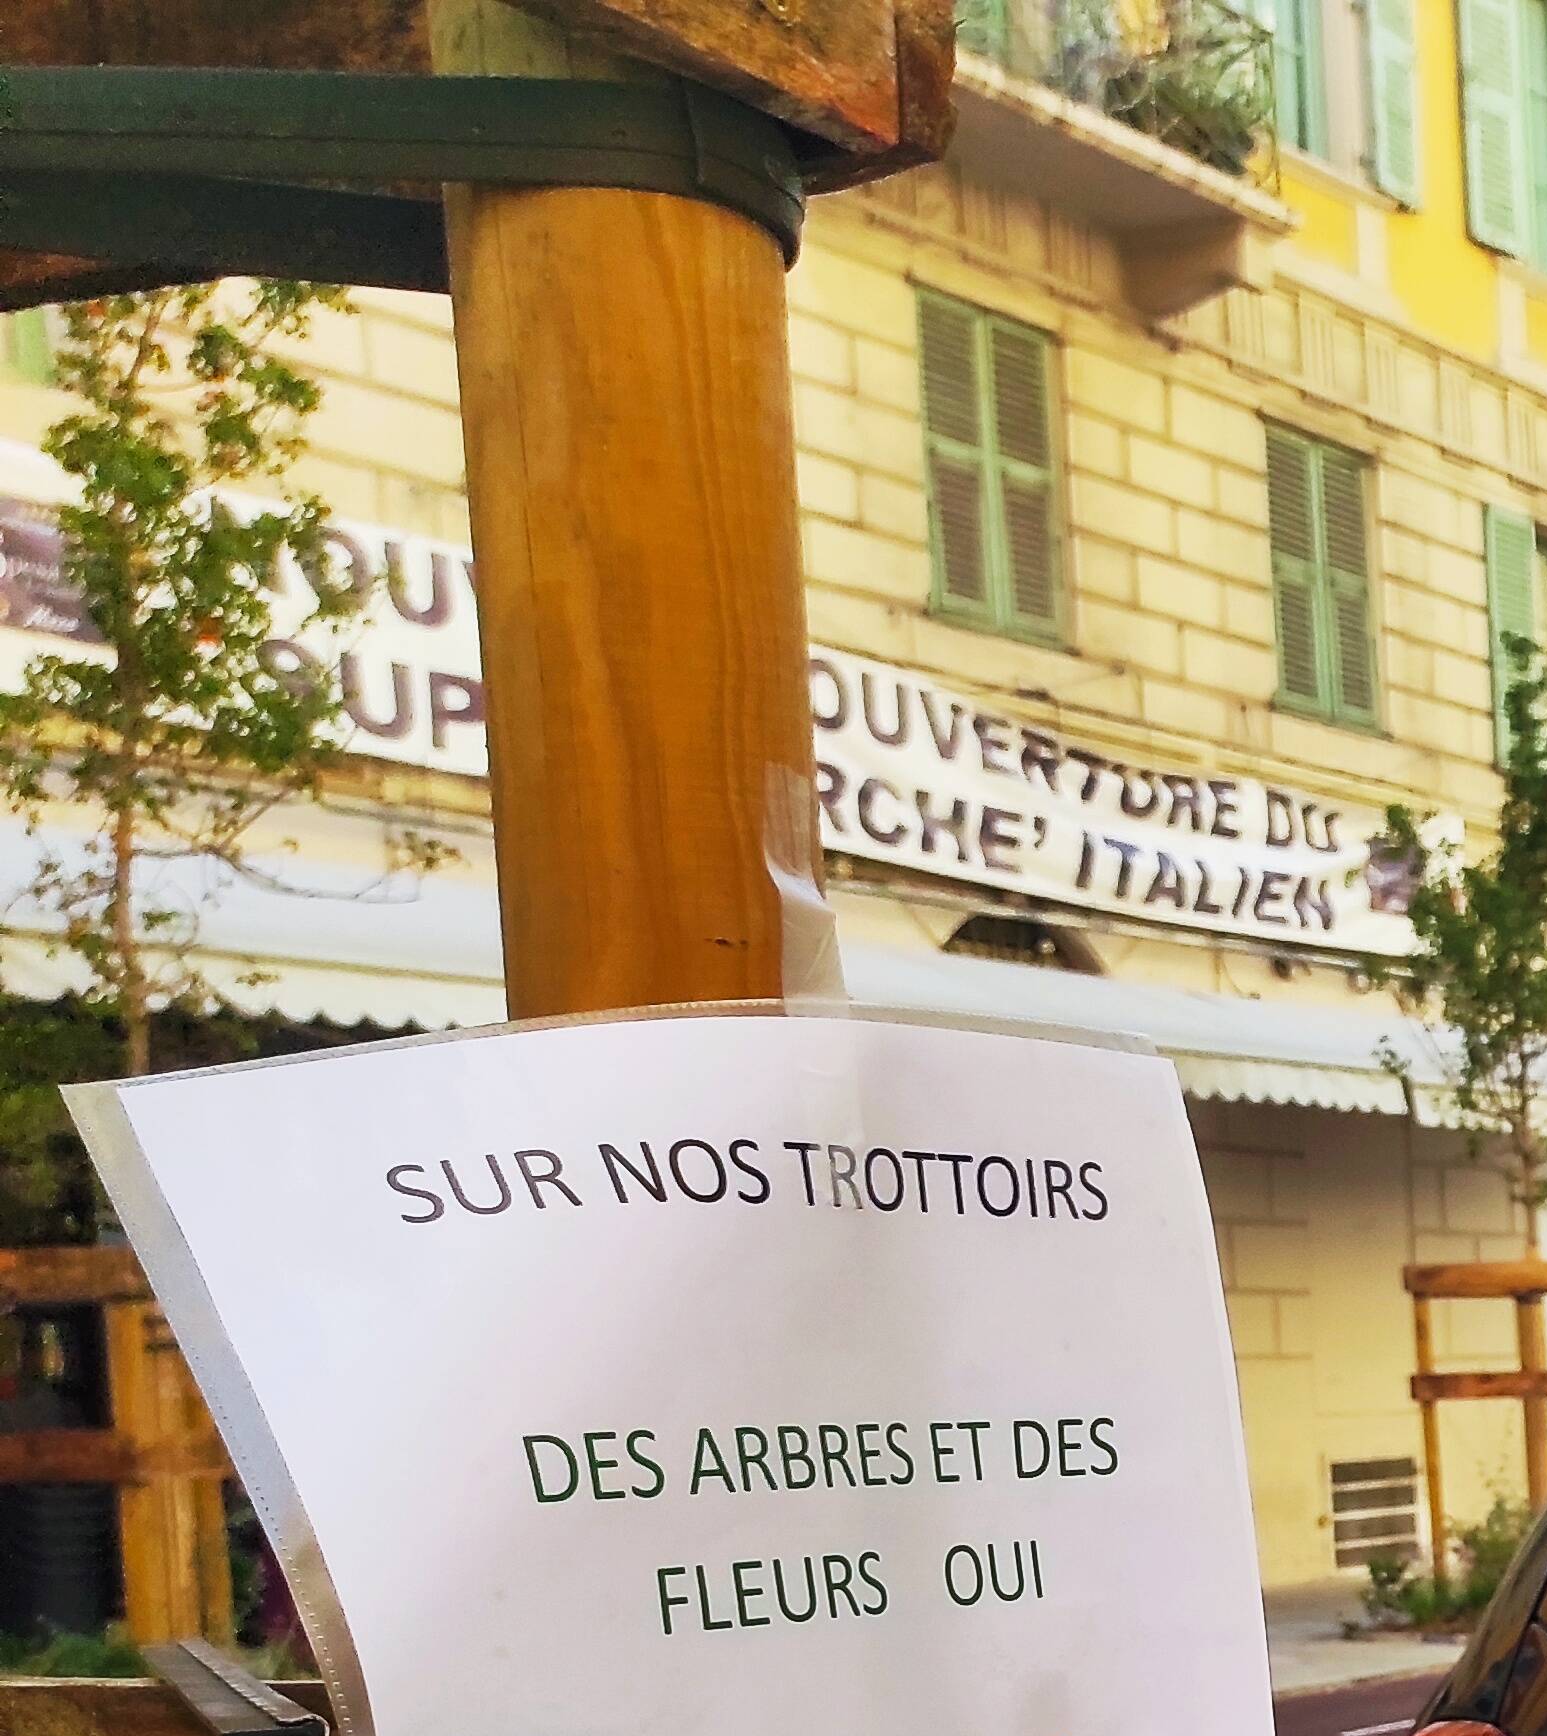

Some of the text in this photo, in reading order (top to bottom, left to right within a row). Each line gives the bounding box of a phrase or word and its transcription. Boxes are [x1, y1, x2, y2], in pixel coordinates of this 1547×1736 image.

[811, 658, 1341, 853] OUVERTURE DU
[1075, 828, 1335, 931] ITALIEN
[385, 1138, 1108, 1223] SUR NOS TROTTOIRS
[523, 1417, 1119, 1504] DES ARBRES ET DES
[657, 1540, 1044, 1636] FLEURS OUI
